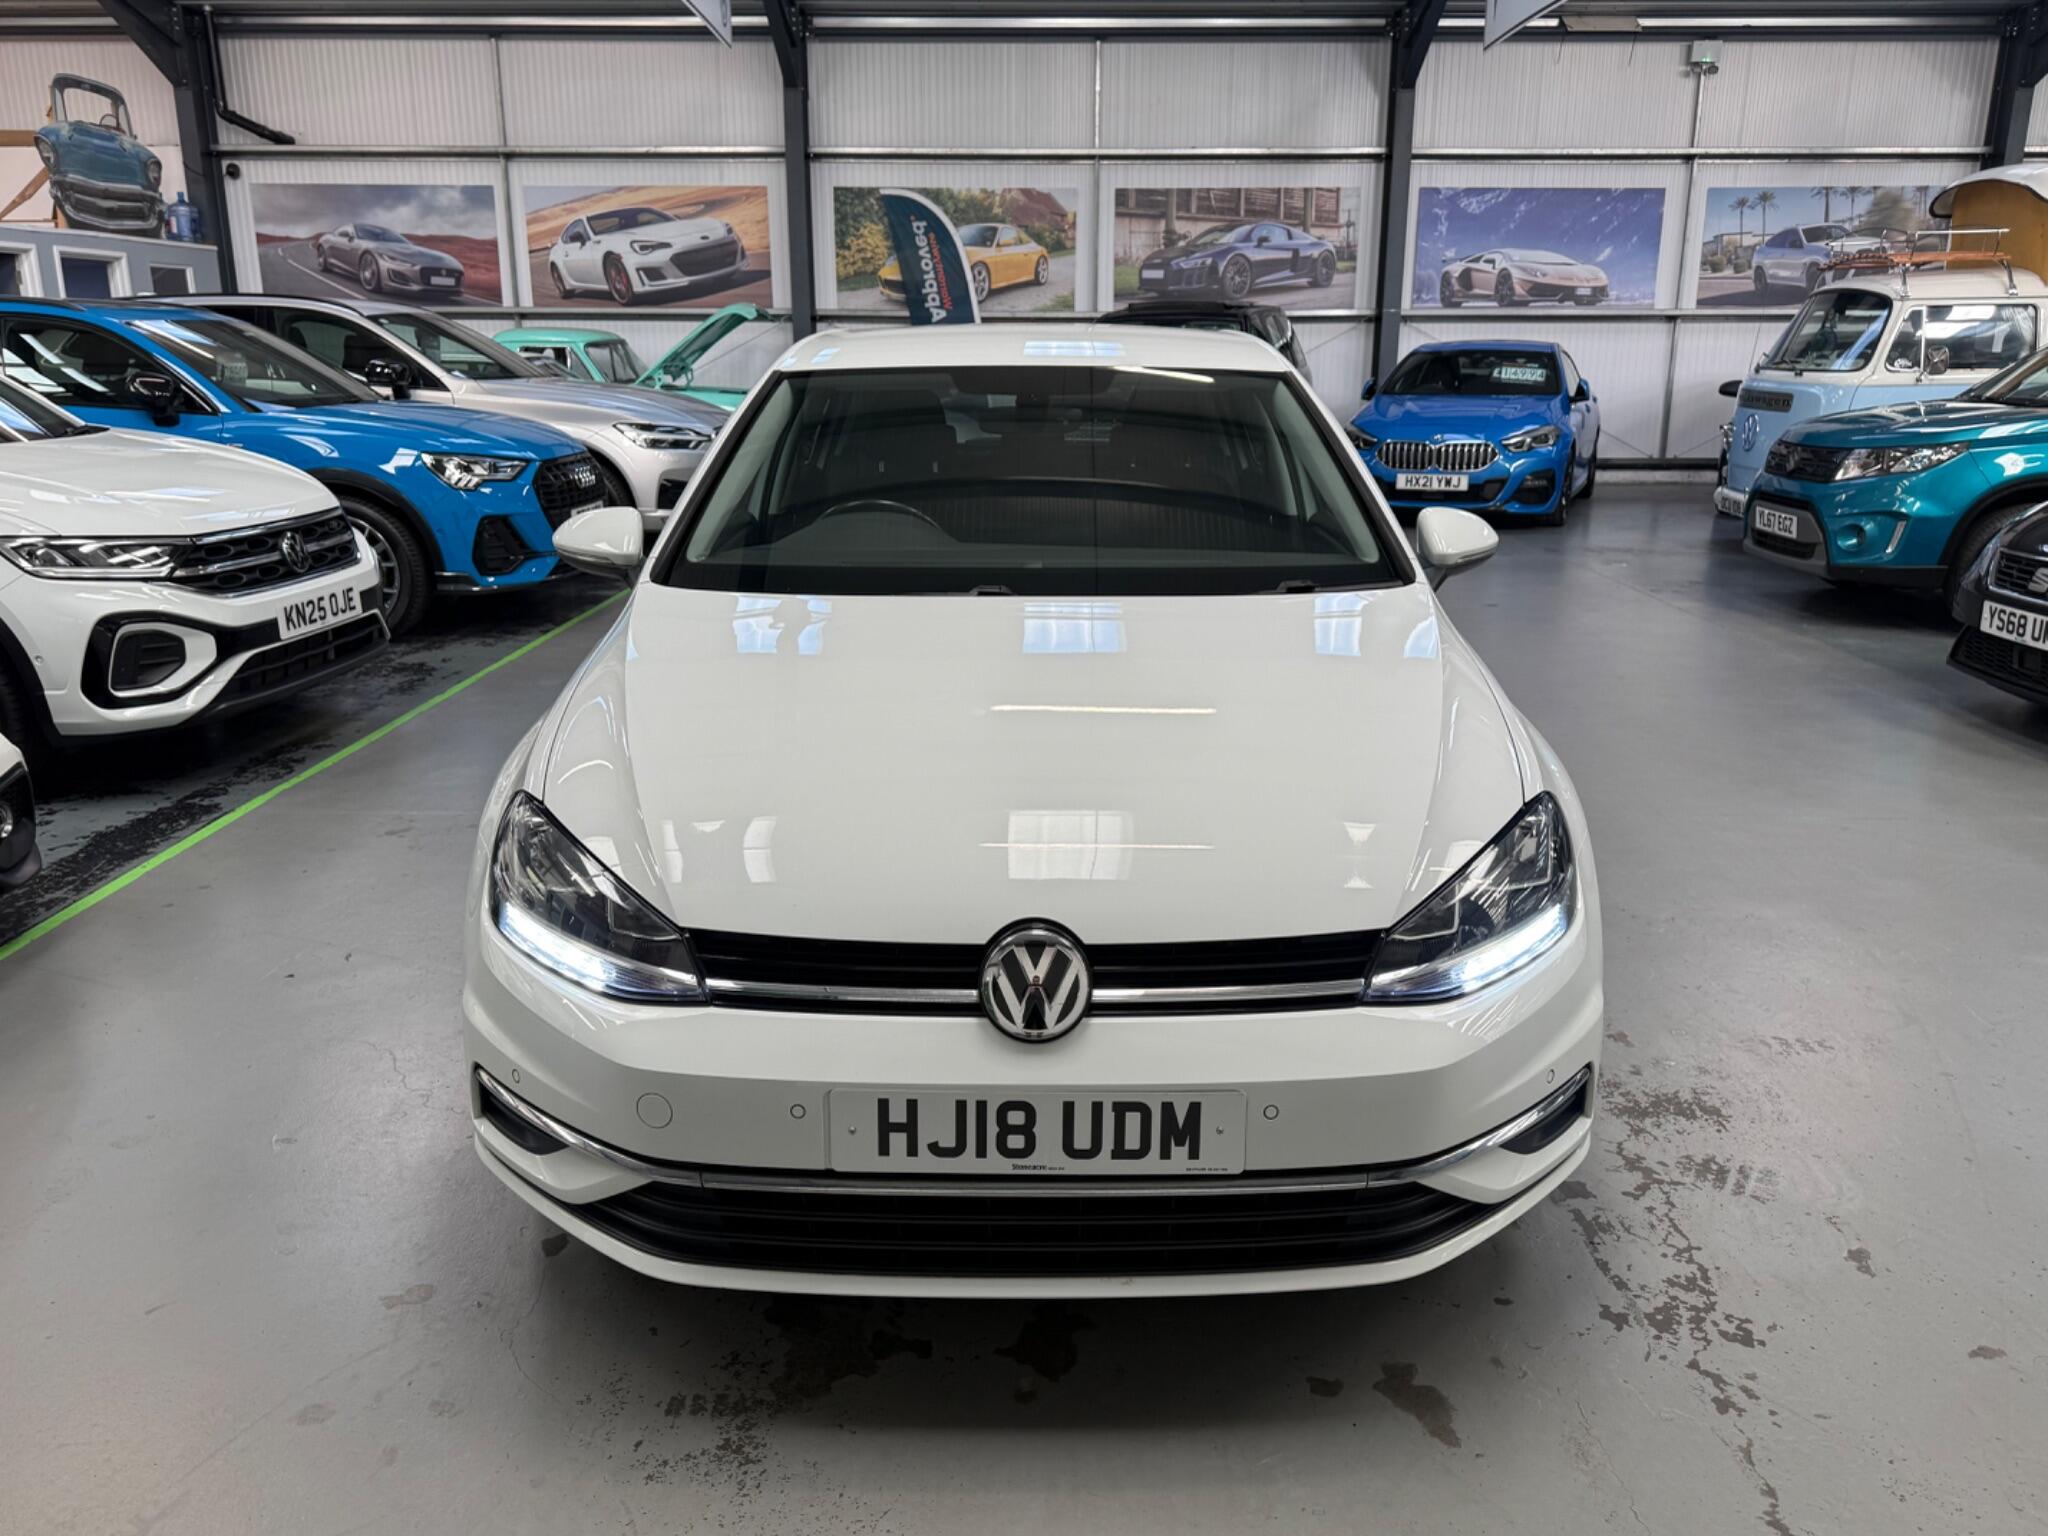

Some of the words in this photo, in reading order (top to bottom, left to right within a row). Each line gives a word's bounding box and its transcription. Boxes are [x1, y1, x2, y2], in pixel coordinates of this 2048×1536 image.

[1405, 475, 1433, 488] HX21
[1436, 476, 1461, 489] YWJ
[1758, 509, 1776, 530] YL67
[1778, 515, 1794, 535] EGZ
[284, 597, 327, 631] KN25
[329, 587, 356, 616] OJE
[1988, 605, 2028, 638] YS68
[877, 1097, 1037, 1160] HJ18
[1062, 1100, 1202, 1161] UDM
